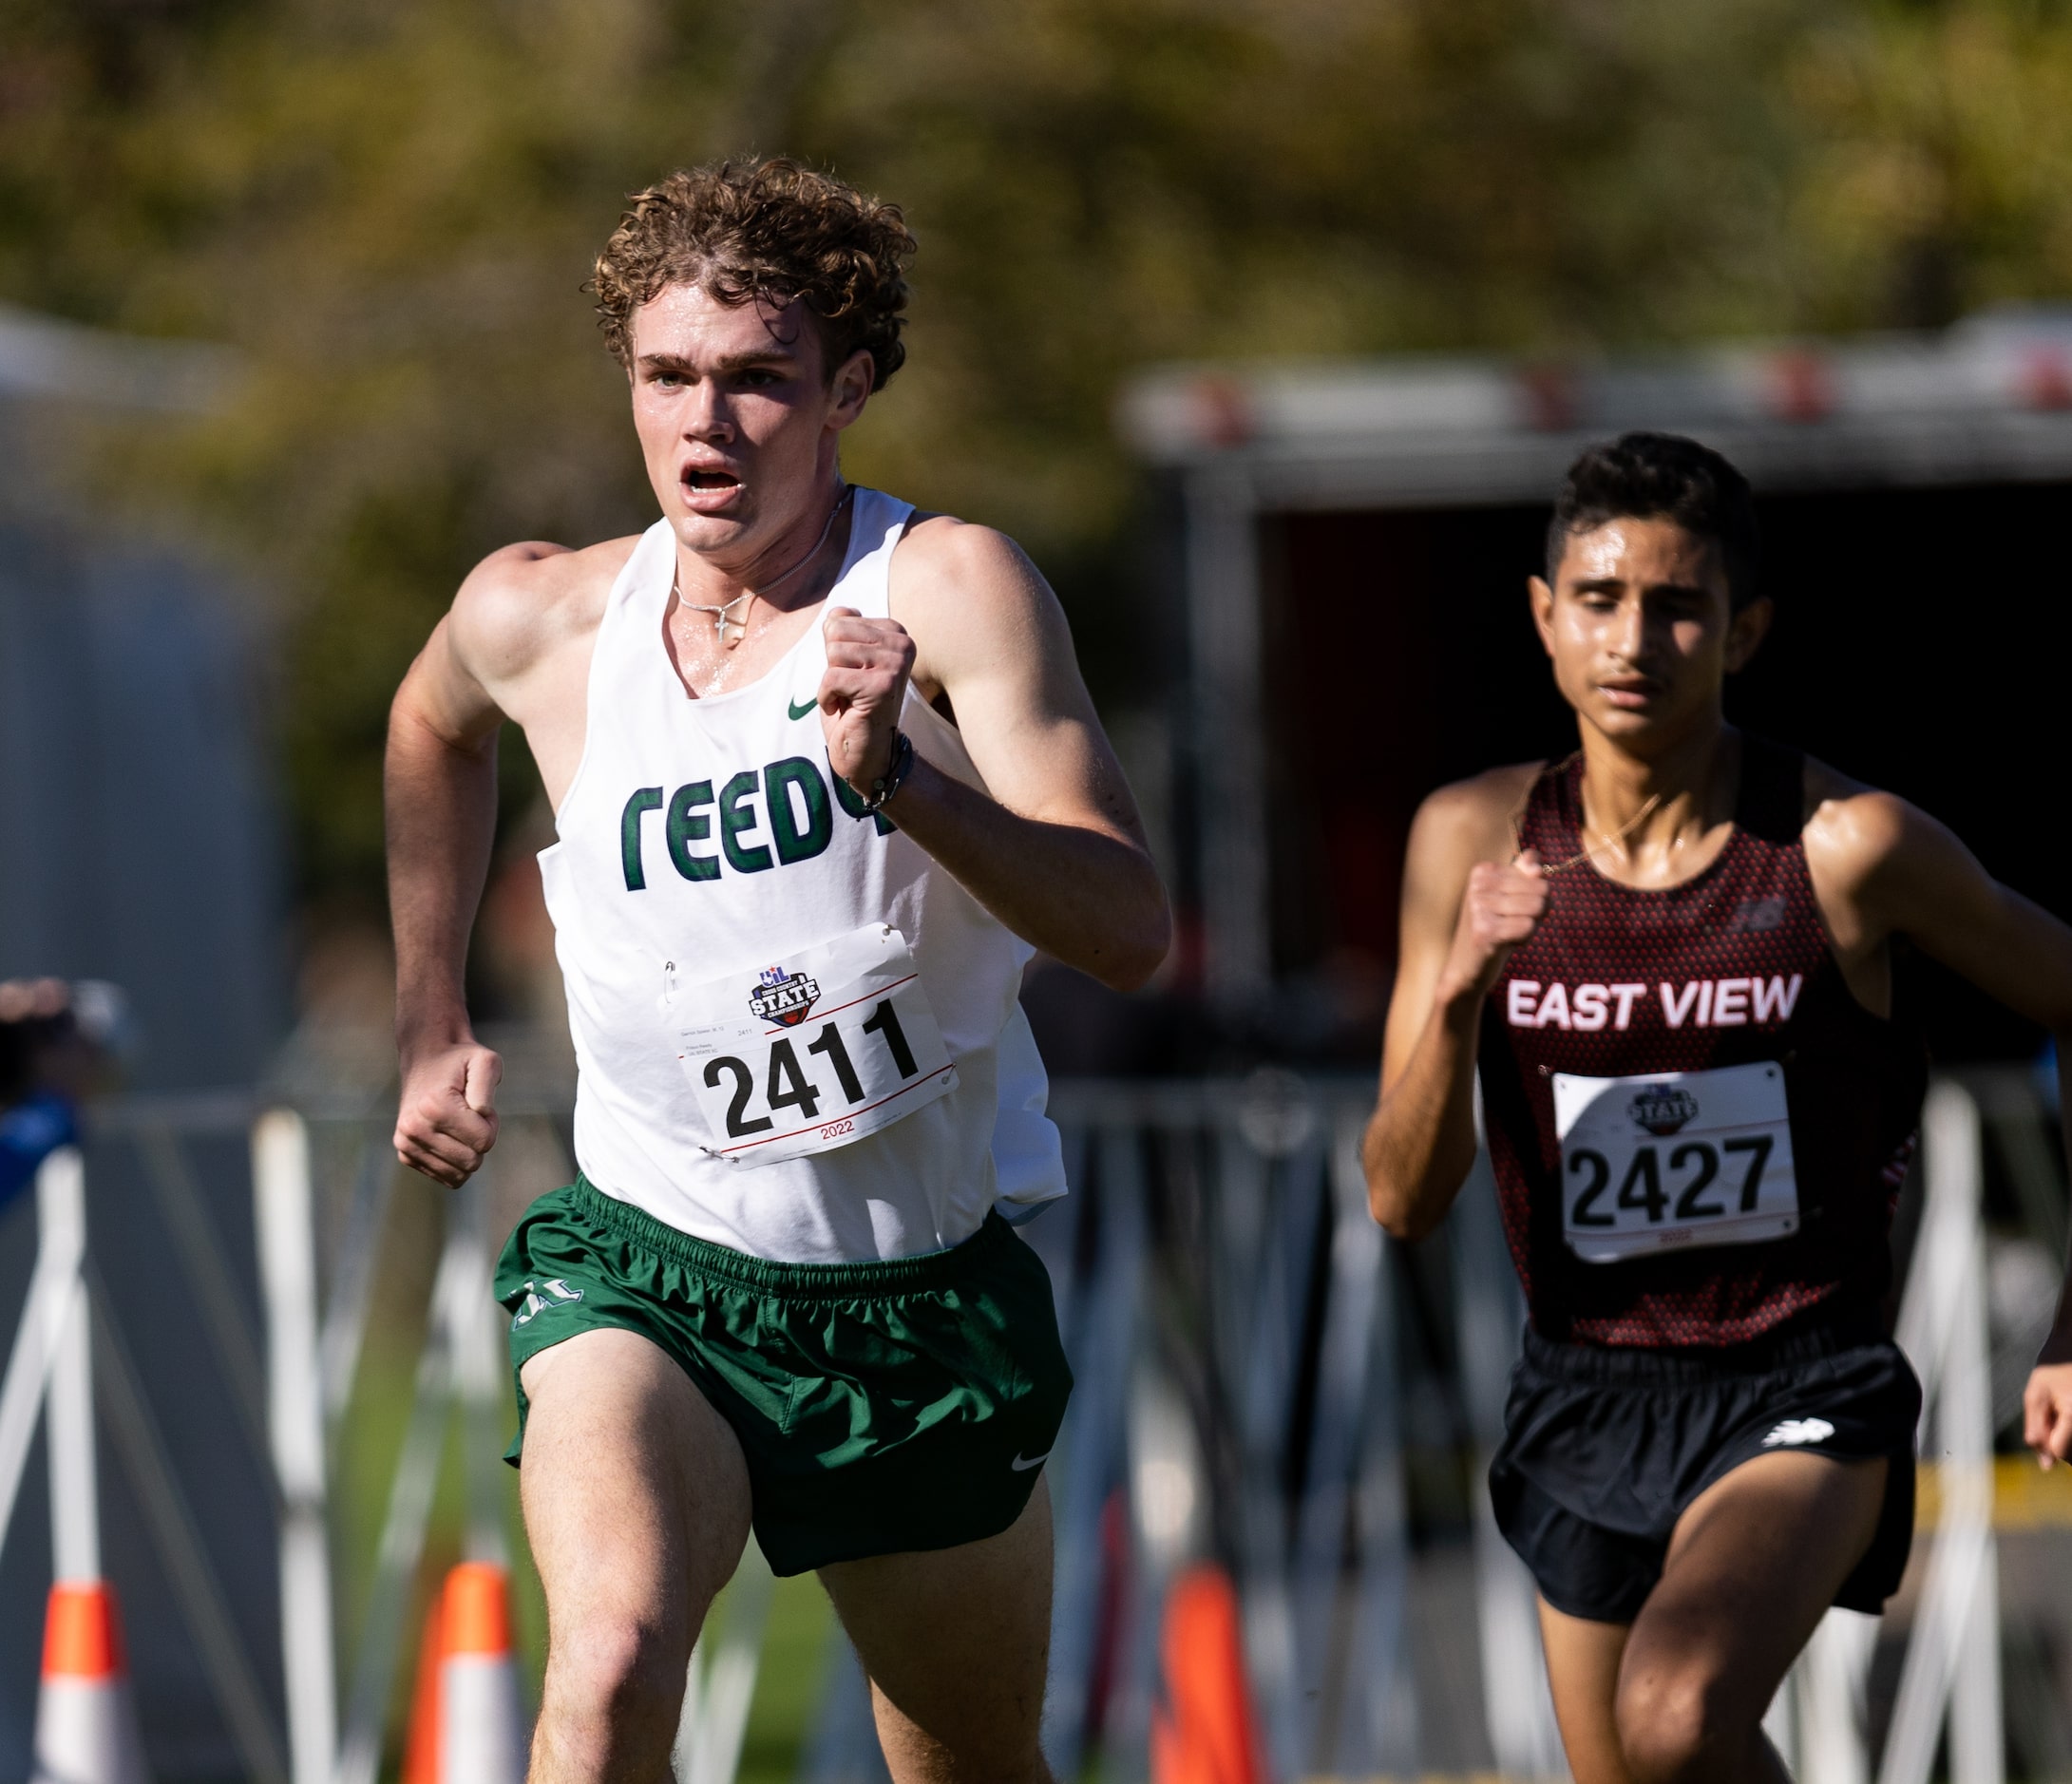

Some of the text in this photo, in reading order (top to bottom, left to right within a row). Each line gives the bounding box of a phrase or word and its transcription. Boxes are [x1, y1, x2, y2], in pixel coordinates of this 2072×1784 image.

[750, 978, 820, 1015] STATE
[1507, 974, 1803, 1031] EAST VIEW
[703, 998, 919, 1138] 2411
[820, 1120, 855, 1140] 2022
[1568, 1133, 1775, 1227] 2427
